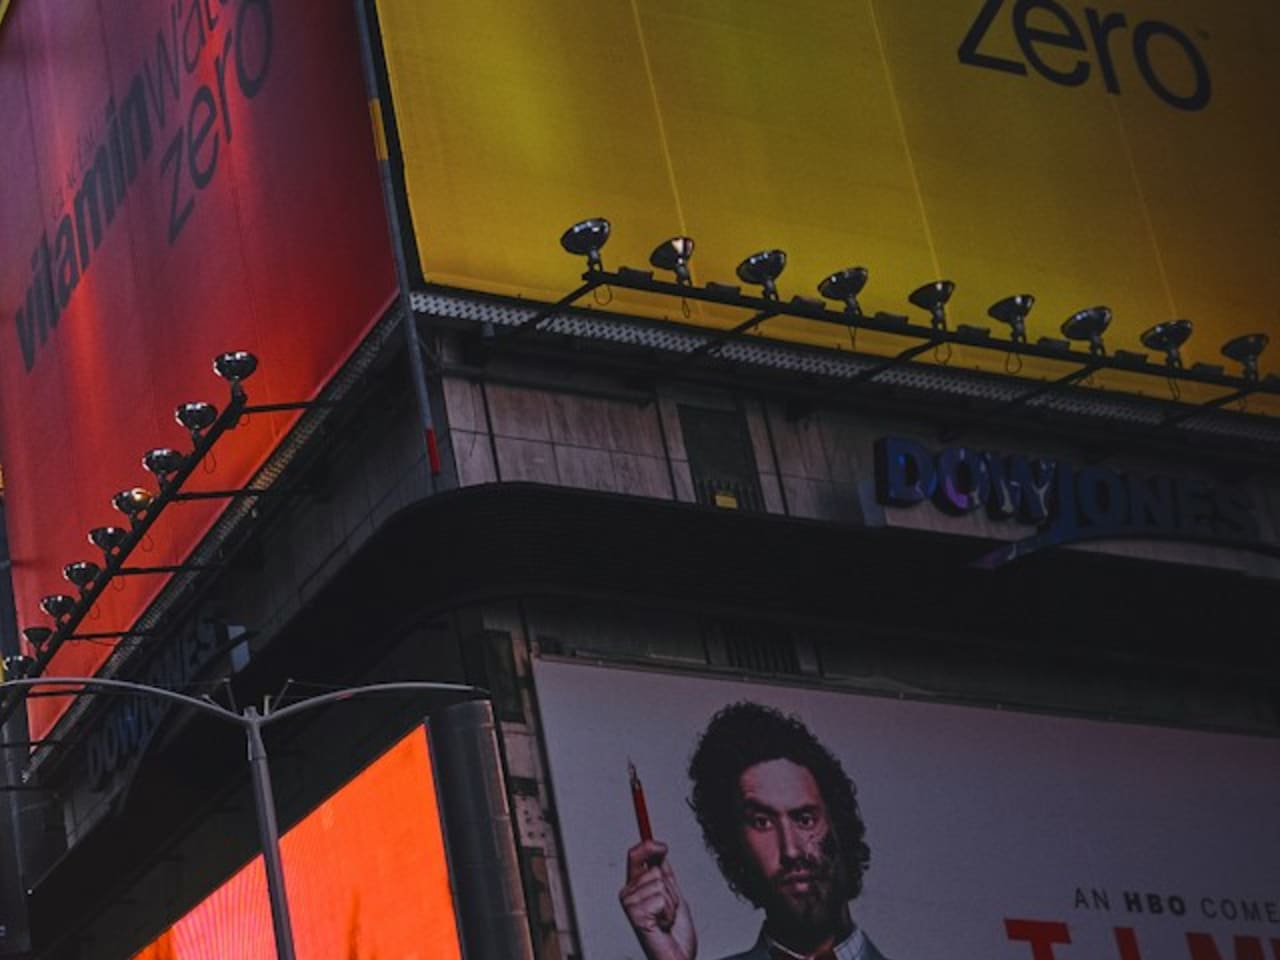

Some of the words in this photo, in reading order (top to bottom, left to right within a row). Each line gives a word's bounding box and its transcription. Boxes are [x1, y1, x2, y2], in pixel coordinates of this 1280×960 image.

[160, 0, 273, 246] zero
[1074, 888, 1112, 912] AN
[1123, 891, 1187, 917] HBO
